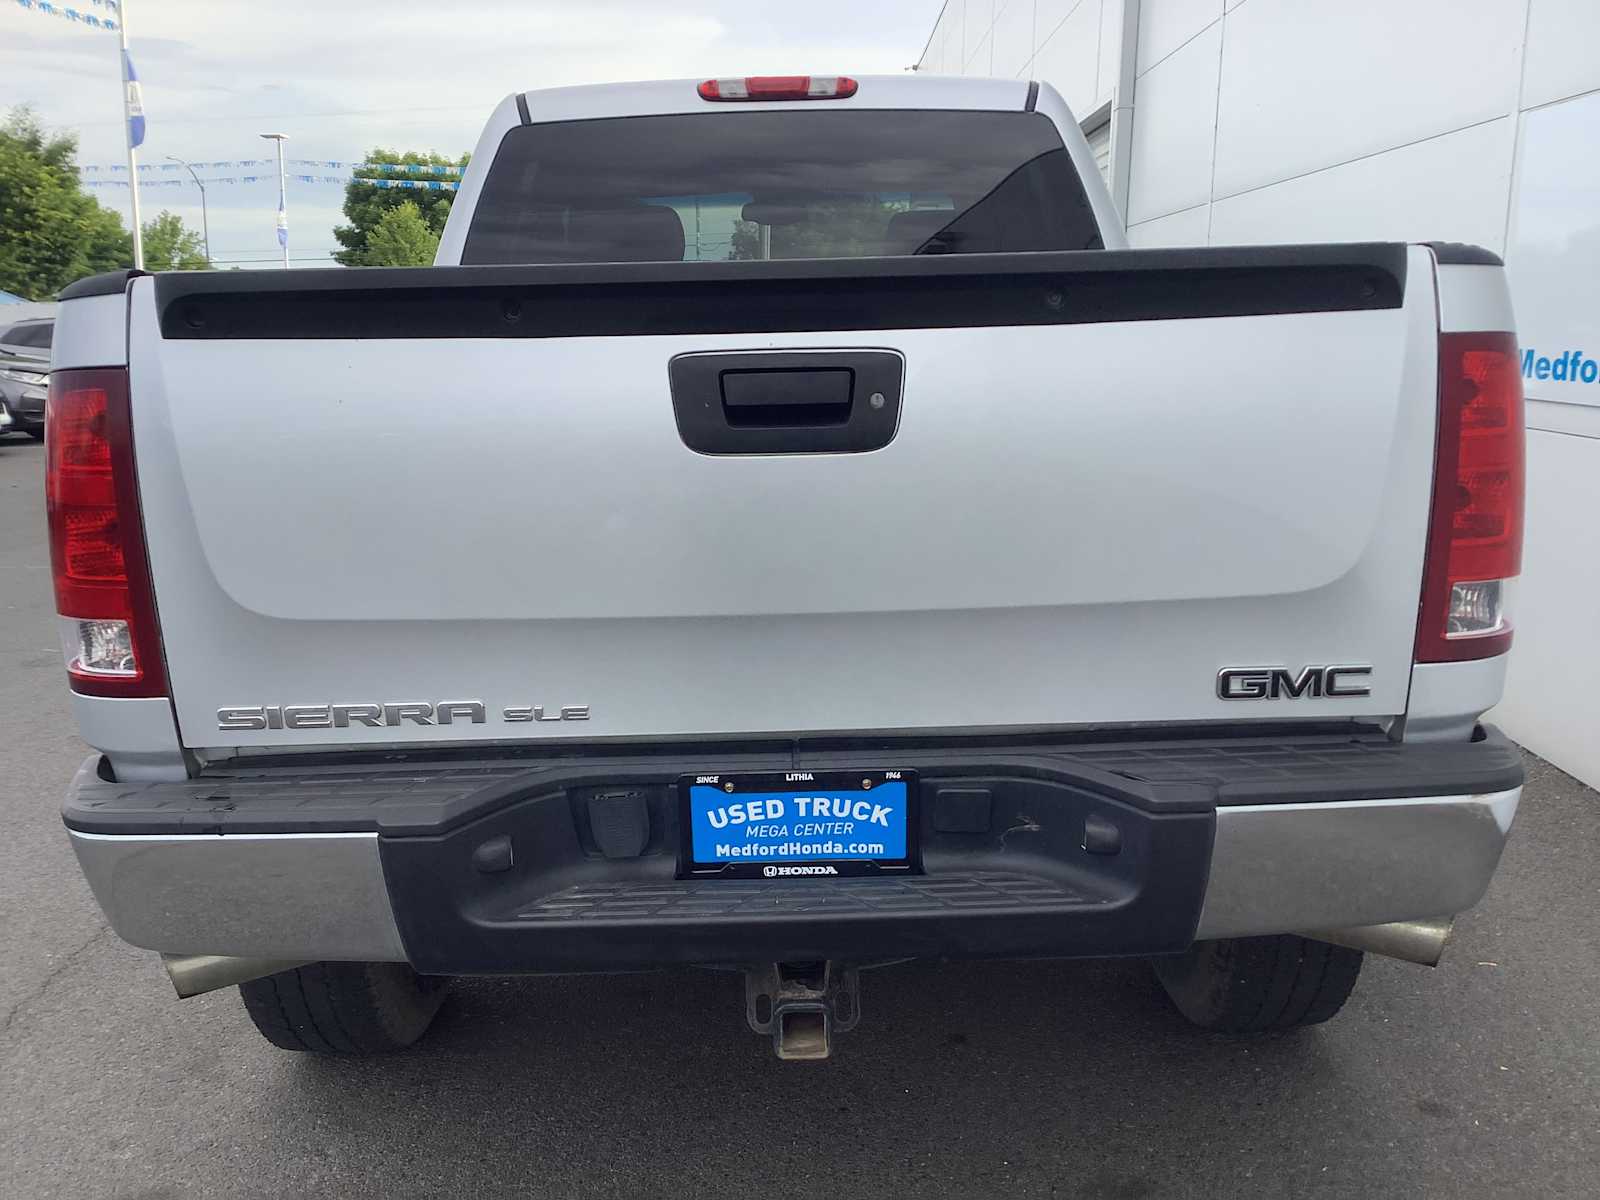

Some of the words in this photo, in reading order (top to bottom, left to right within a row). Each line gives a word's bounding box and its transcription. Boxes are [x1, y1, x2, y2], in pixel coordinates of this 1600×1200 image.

[1519, 349, 1600, 384] Medfo
[1217, 665, 1373, 700] GMC
[216, 699, 486, 730] SIERRA
[503, 704, 590, 722] SLE
[696, 776, 719, 784] SINCE
[785, 773, 813, 781] LITHIA
[706, 799, 785, 829] USED
[793, 797, 893, 827] TRUCK
[746, 825, 789, 838] MEGA
[794, 822, 854, 836] CENTER
[716, 841, 884, 857] MedfordHonda.com
[778, 866, 838, 876] HONDA
